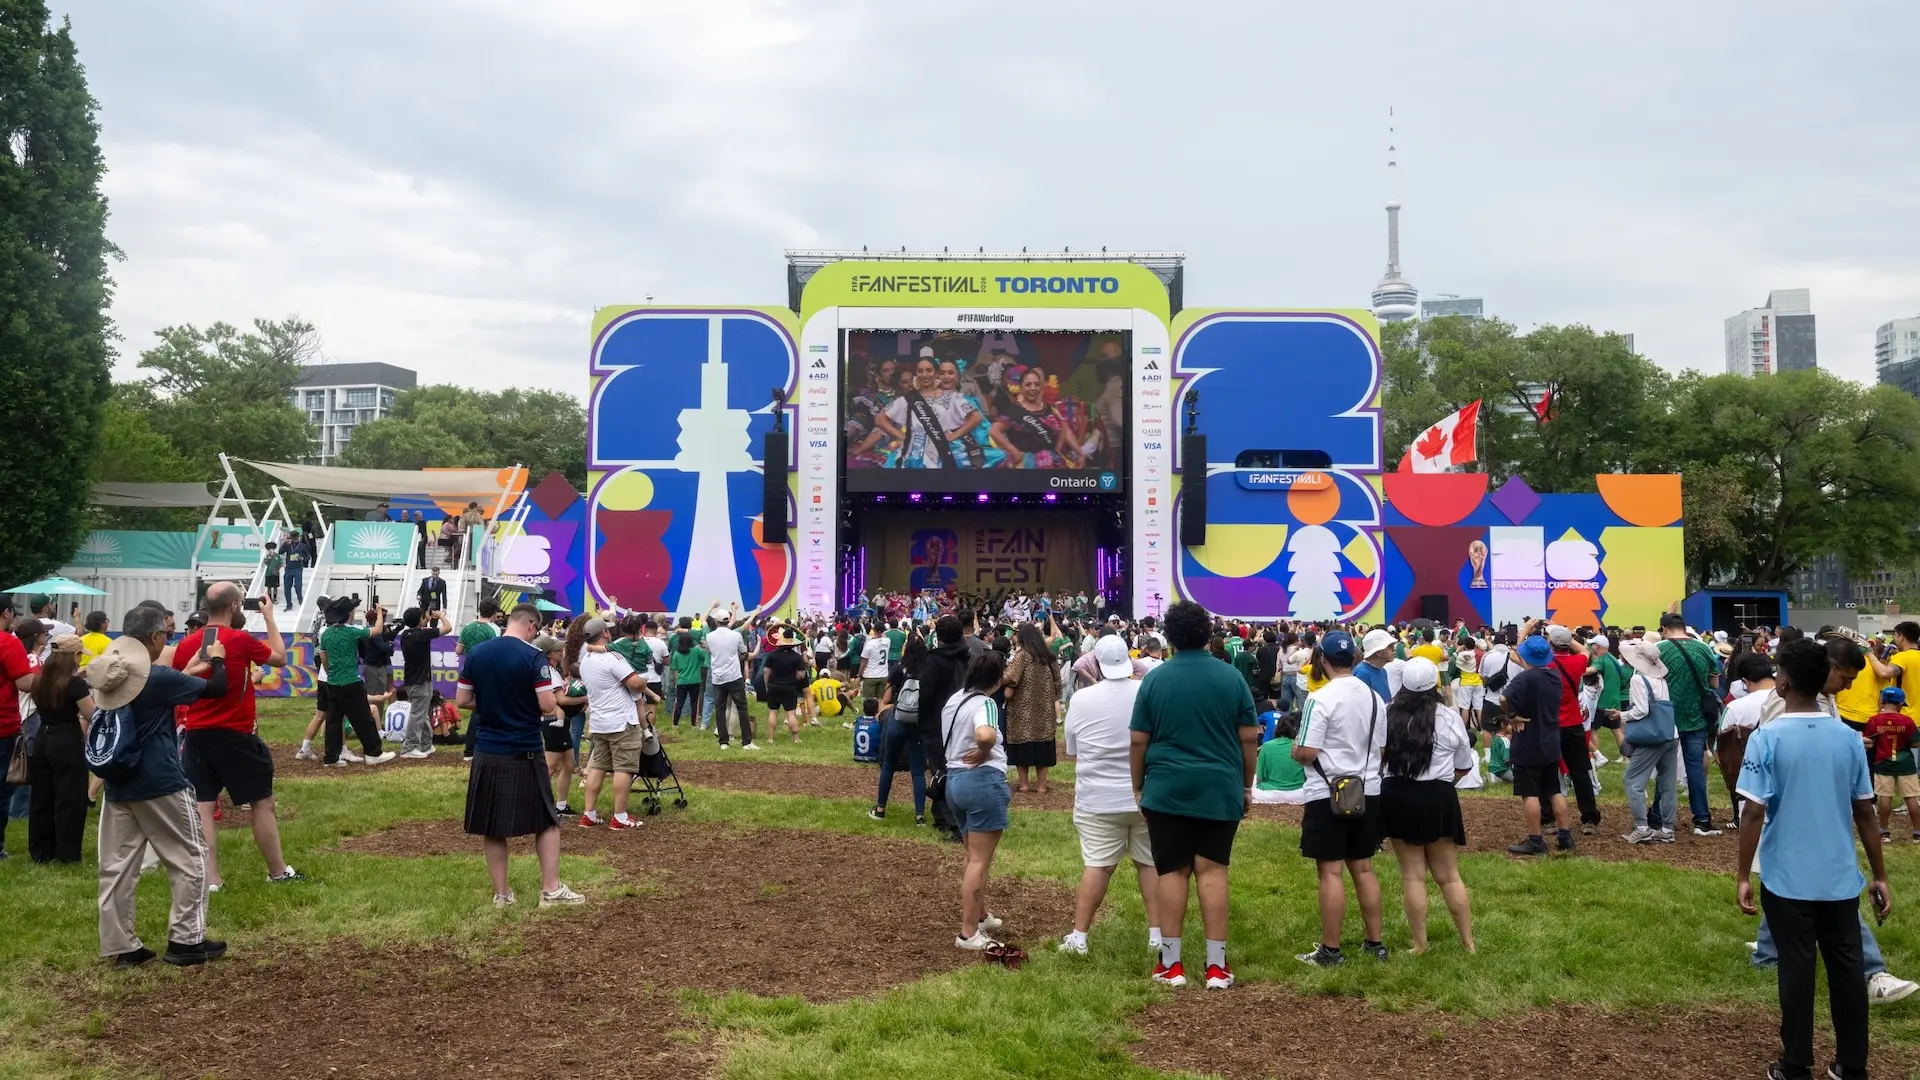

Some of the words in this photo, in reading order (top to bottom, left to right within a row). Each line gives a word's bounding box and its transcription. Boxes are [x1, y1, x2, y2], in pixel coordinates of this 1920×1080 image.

[995, 277, 1119, 293] TORONTO
[957, 314, 1014, 324] #FIFAWorldCup
[914, 400, 941, 441] Campeche
[1050, 476, 1097, 488] Ontario
[976, 529, 984, 553] FIFA
[987, 528, 1044, 554] FAN
[347, 551, 402, 560] CASAMIGOS
[976, 558, 1046, 583] FEST
[519, 576, 551, 584] 2026
[1547, 581, 1566, 589] CUP
[1567, 581, 1600, 589] 2026
[879, 649, 887, 665] 3
[820, 686, 836, 700] 10
[387, 711, 406, 731] 10
[856, 730, 870, 754] 9
[1887, 734, 1898, 761] 7
